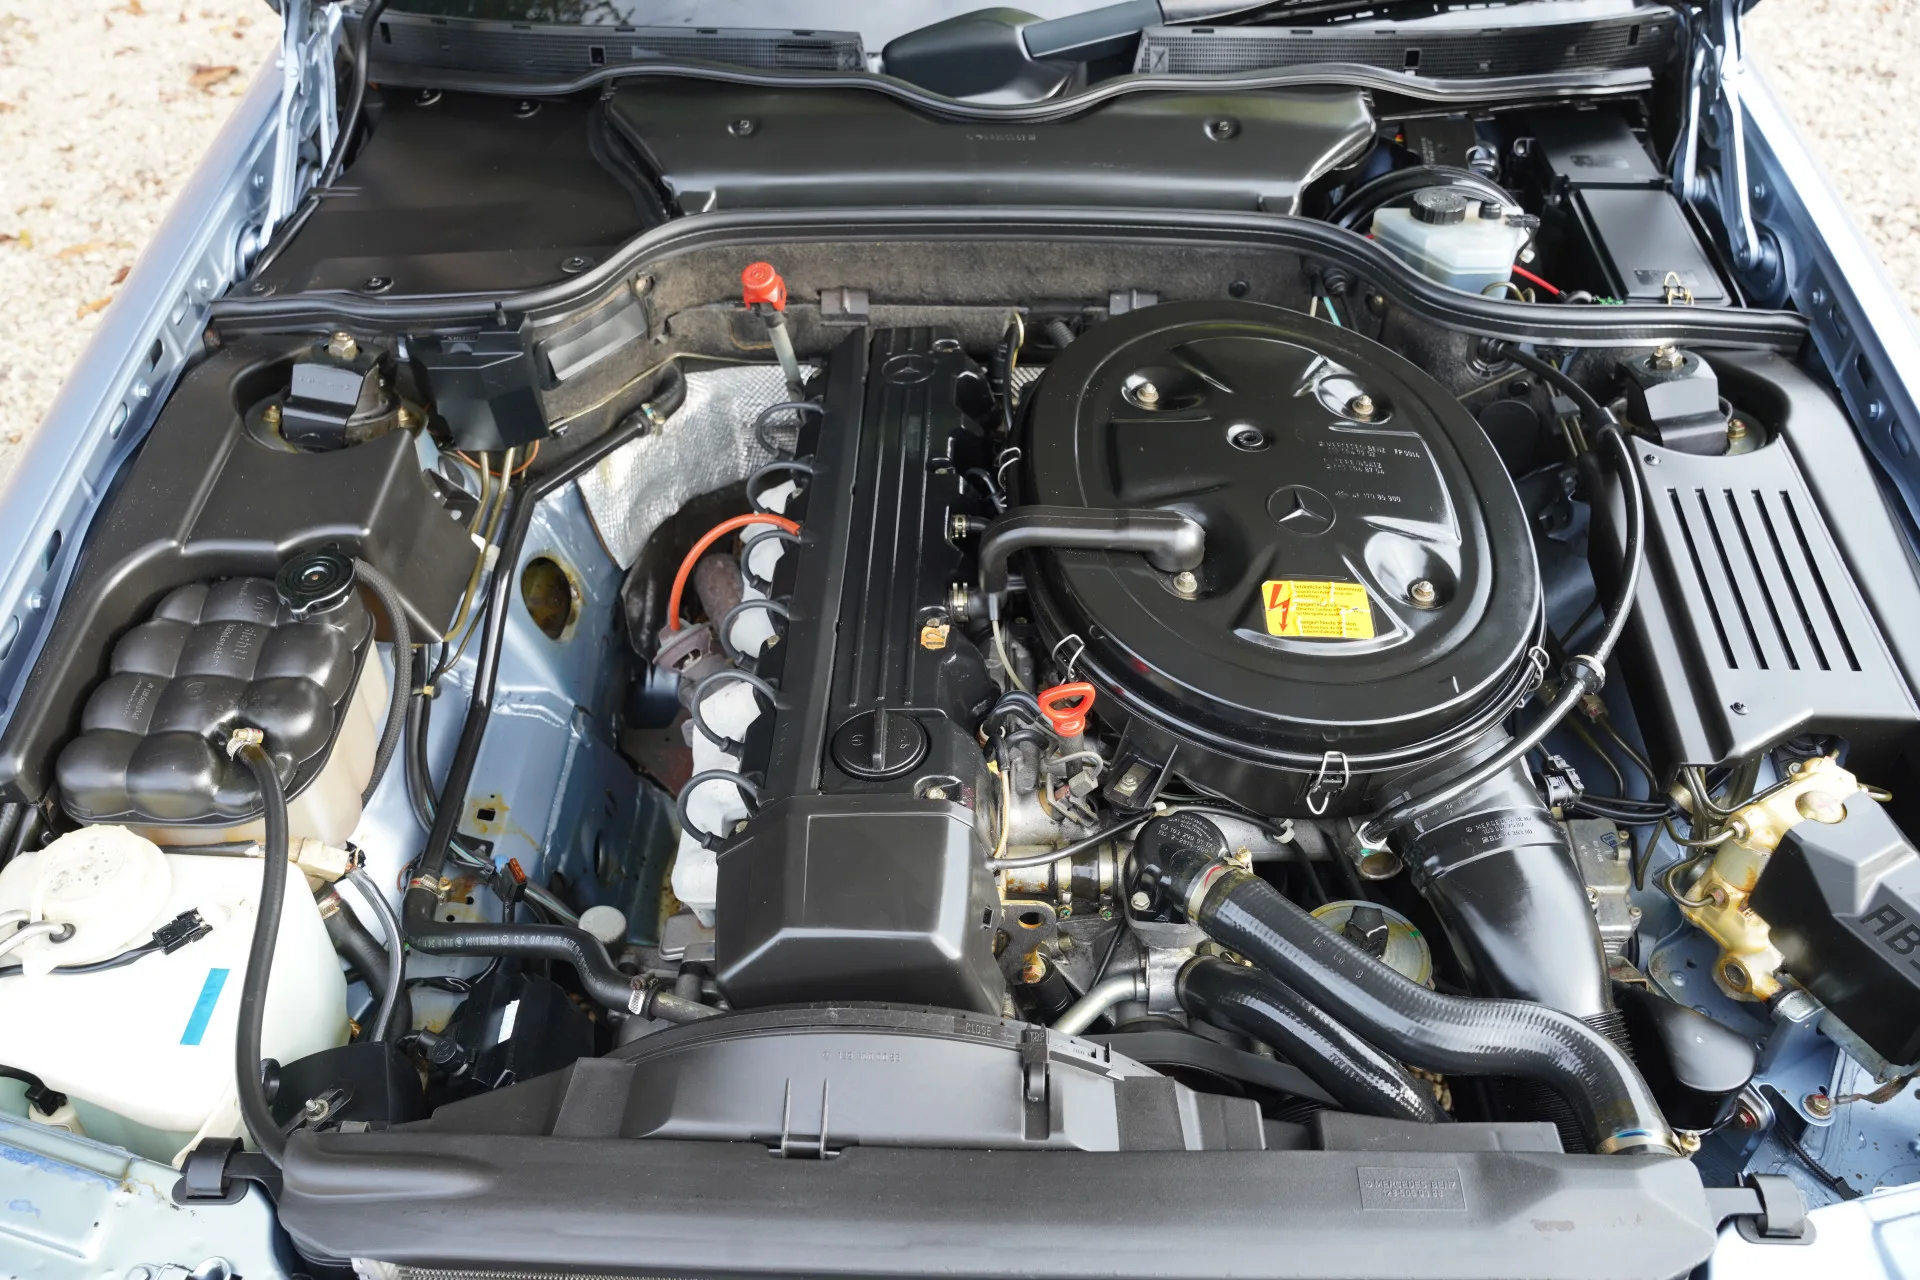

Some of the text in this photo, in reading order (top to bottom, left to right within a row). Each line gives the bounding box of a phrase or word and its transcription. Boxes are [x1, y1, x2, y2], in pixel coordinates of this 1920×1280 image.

[1859, 903, 1920, 974] AB
[965, 1022, 993, 1037] CLOSE
[1029, 1031, 1045, 1042] TOP
